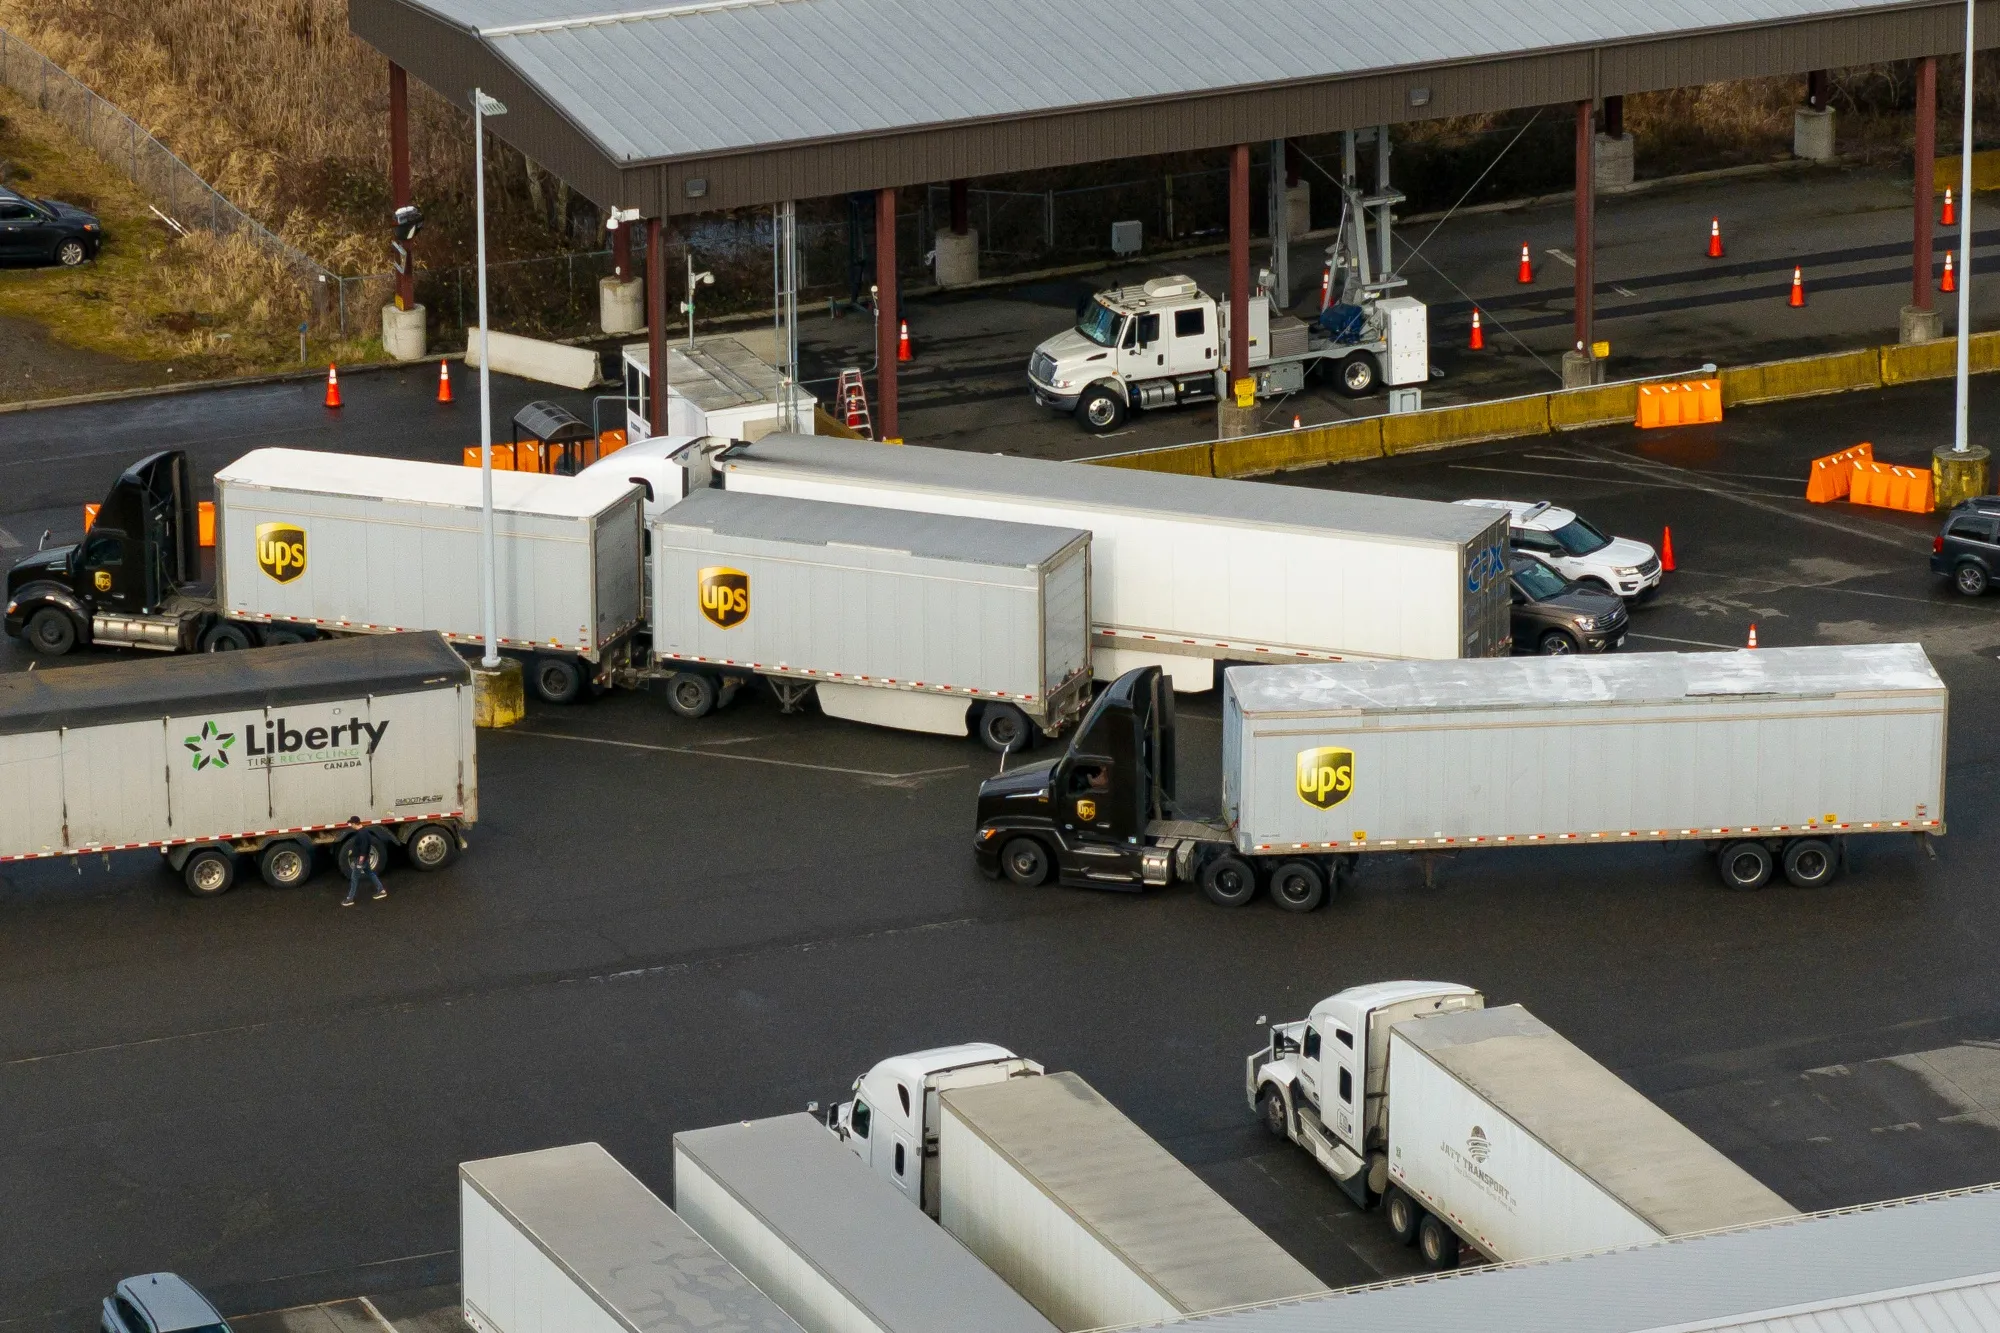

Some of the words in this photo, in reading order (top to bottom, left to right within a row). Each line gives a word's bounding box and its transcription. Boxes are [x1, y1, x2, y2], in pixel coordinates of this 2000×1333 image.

[261, 541, 304, 575] ups
[702, 585, 747, 620] ups
[245, 717, 390, 757] Liberty
[247, 755, 275, 767] TIRE
[280, 748, 360, 764] RECYCLING
[323, 759, 362, 771] CANADA
[1300, 765, 1351, 802] ups
[1079, 804, 1094, 819] ups
[1462, 1156, 1510, 1200] TRANSPORT
